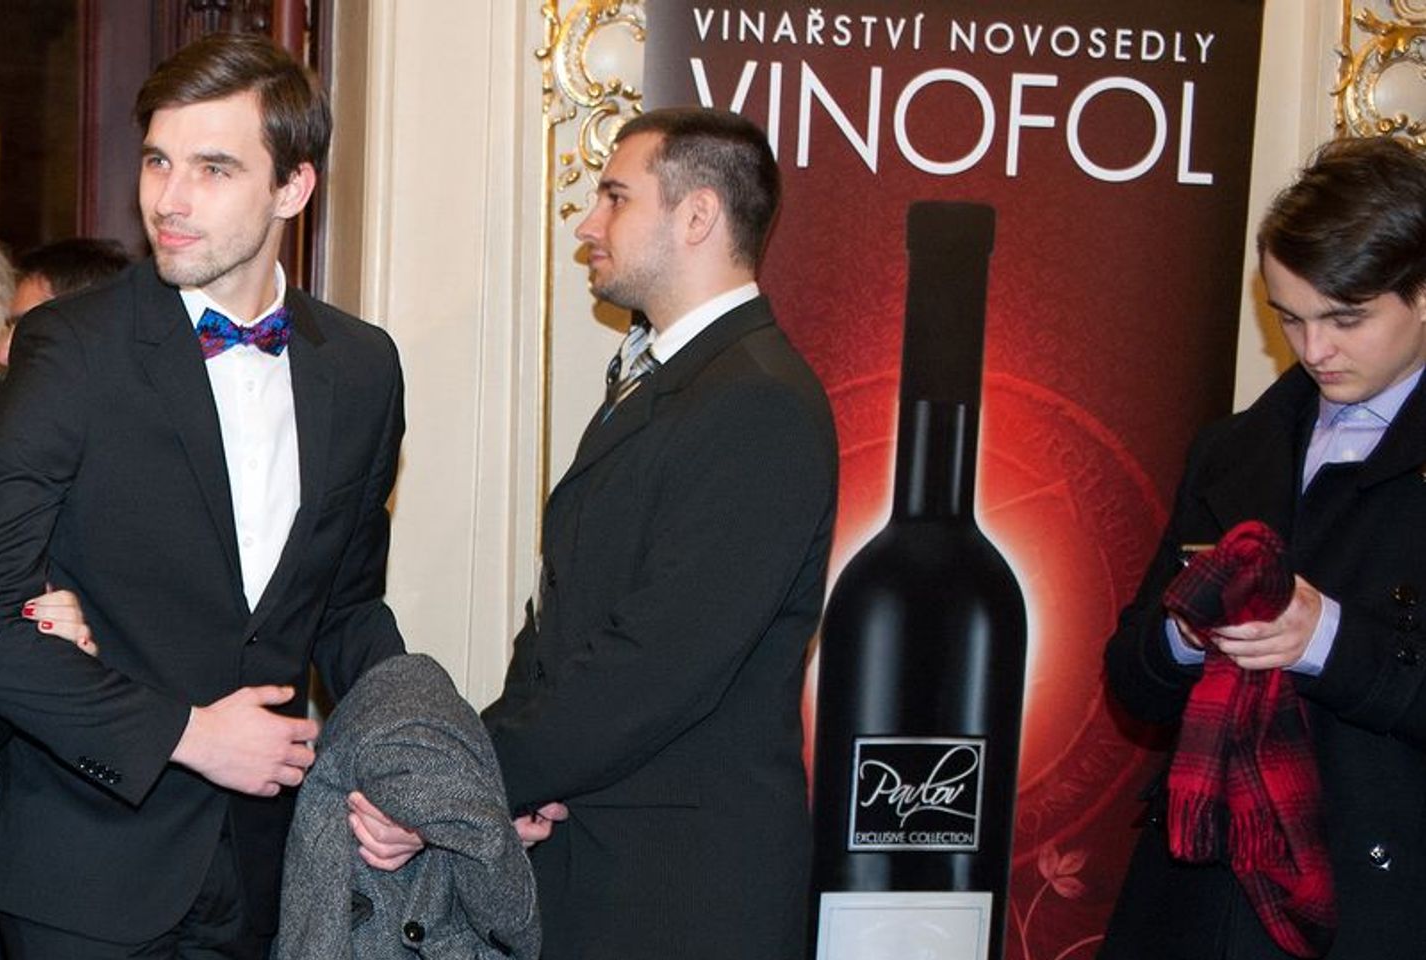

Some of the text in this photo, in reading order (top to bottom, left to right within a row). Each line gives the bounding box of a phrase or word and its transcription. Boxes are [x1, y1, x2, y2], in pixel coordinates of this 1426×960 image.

[693, 8, 1215, 63] VINAŘSTVÍ NOVOSEDLY
[689, 58, 1213, 184] VINOFOL
[859, 746, 978, 828] Pavlov
[909, 832, 973, 845] COLLECTION
